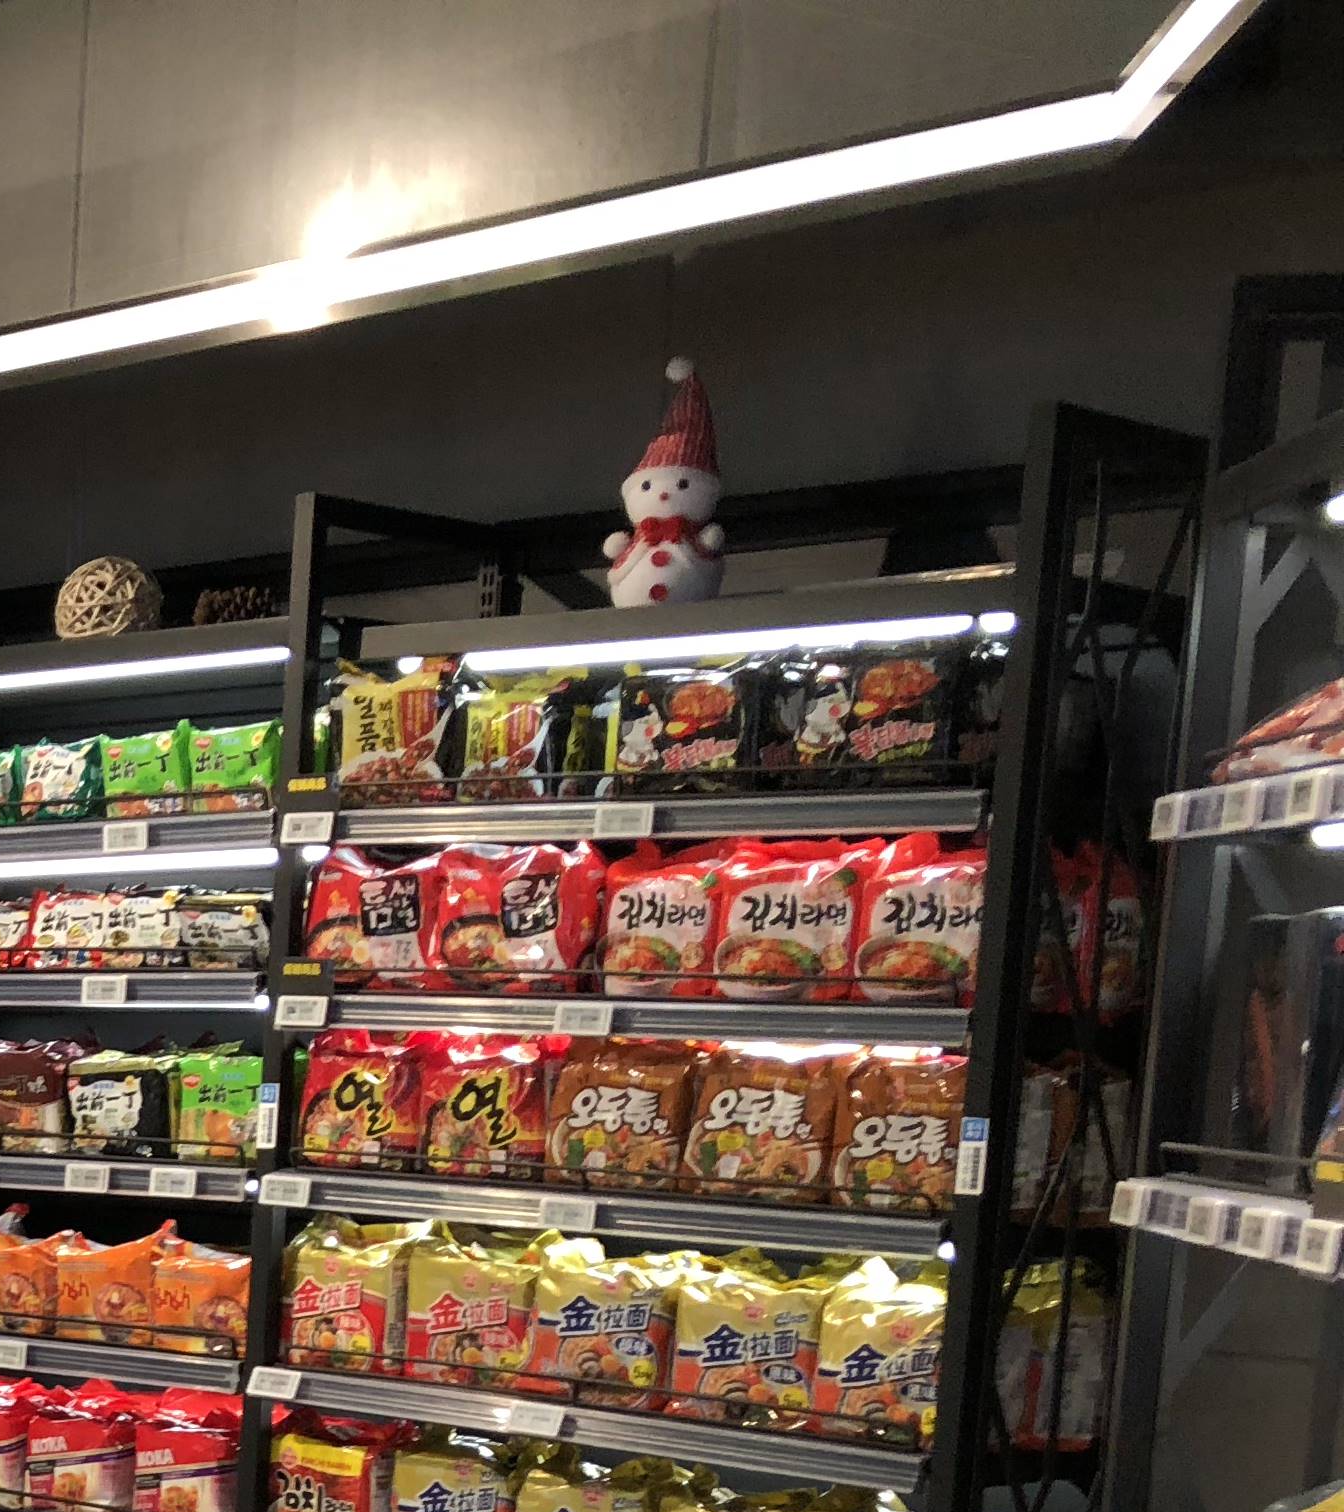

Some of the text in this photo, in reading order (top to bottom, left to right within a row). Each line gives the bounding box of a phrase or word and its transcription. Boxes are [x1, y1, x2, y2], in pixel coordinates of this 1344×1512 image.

[618, 889, 707, 931] 김치라면
[740, 888, 848, 932] 김치라면
[427, 1292, 509, 1335] 金拉面
[558, 1296, 654, 1337] 金拉面
[699, 1322, 798, 1367] 金拉面
[31, 1436, 69, 1453] KOKA
